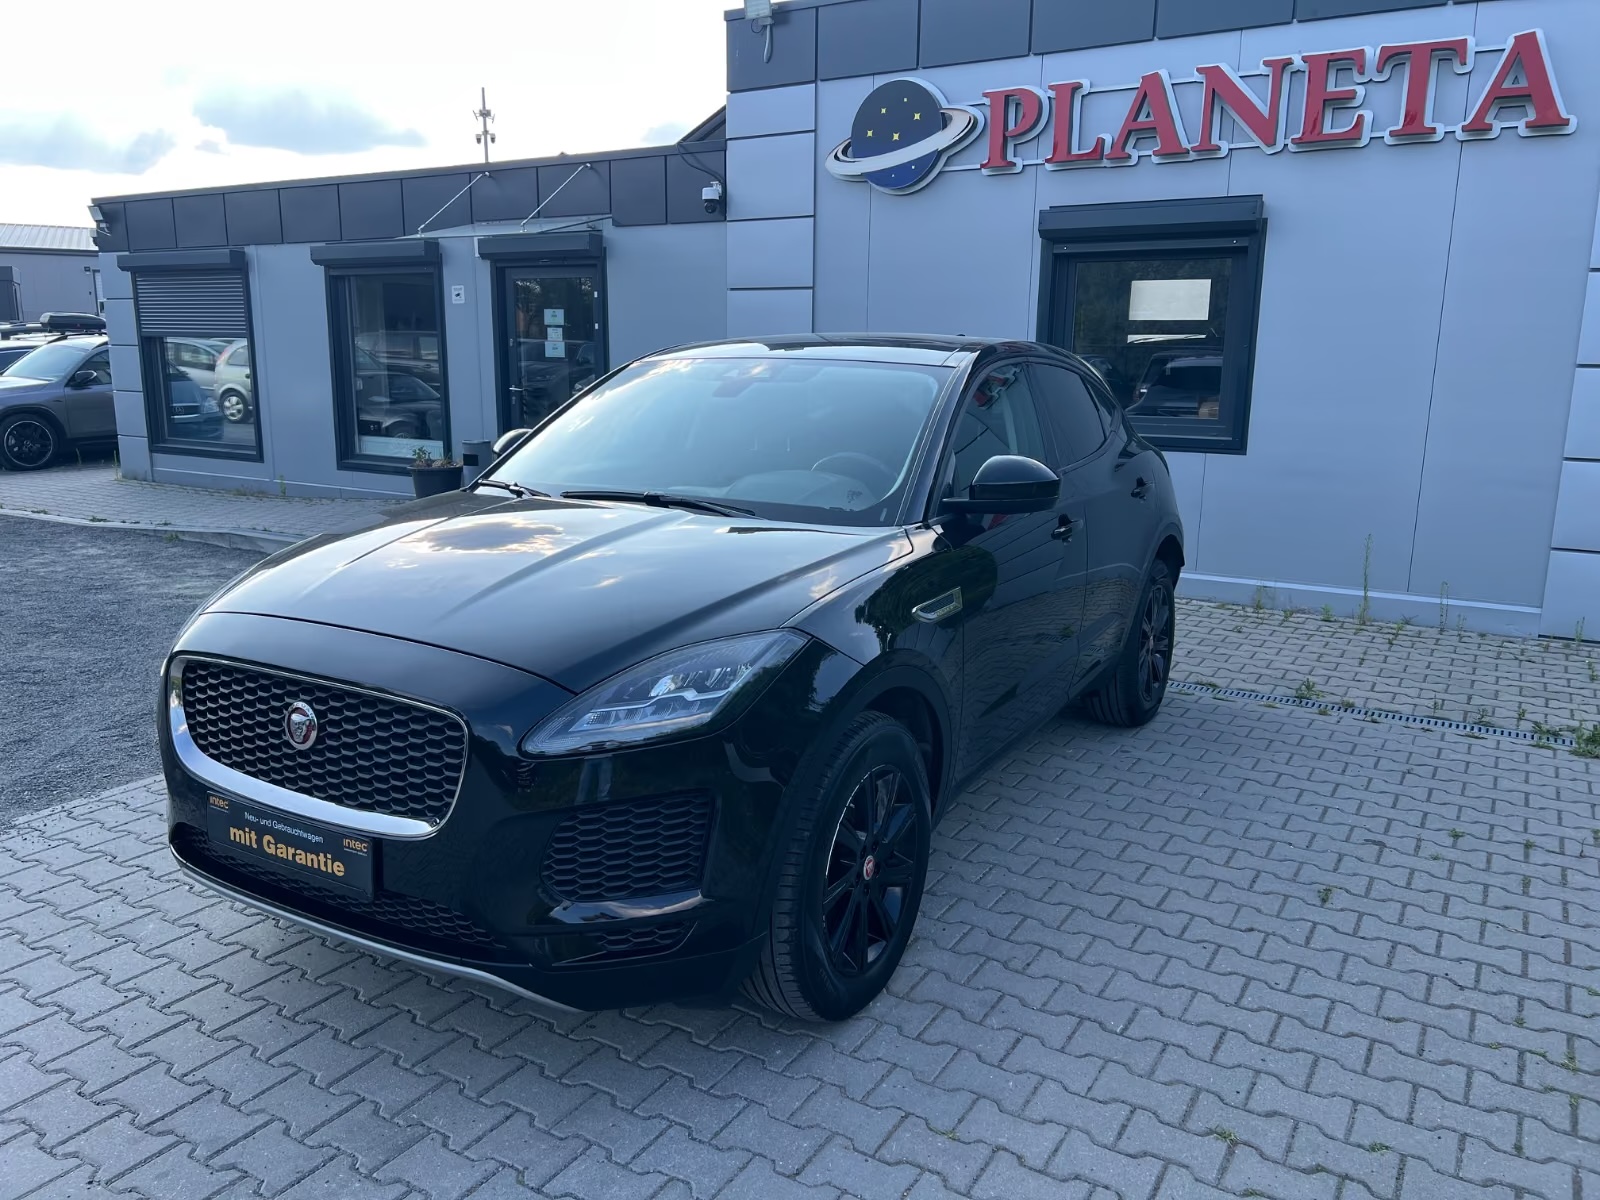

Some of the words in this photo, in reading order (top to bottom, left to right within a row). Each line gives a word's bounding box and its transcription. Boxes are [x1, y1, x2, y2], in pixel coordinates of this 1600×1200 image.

[980, 29, 1573, 172] PLANETA
[209, 795, 229, 809] intec
[259, 818, 272, 827] und
[229, 826, 258, 849] mit
[262, 834, 345, 877] Garantie
[343, 838, 368, 852] intec
